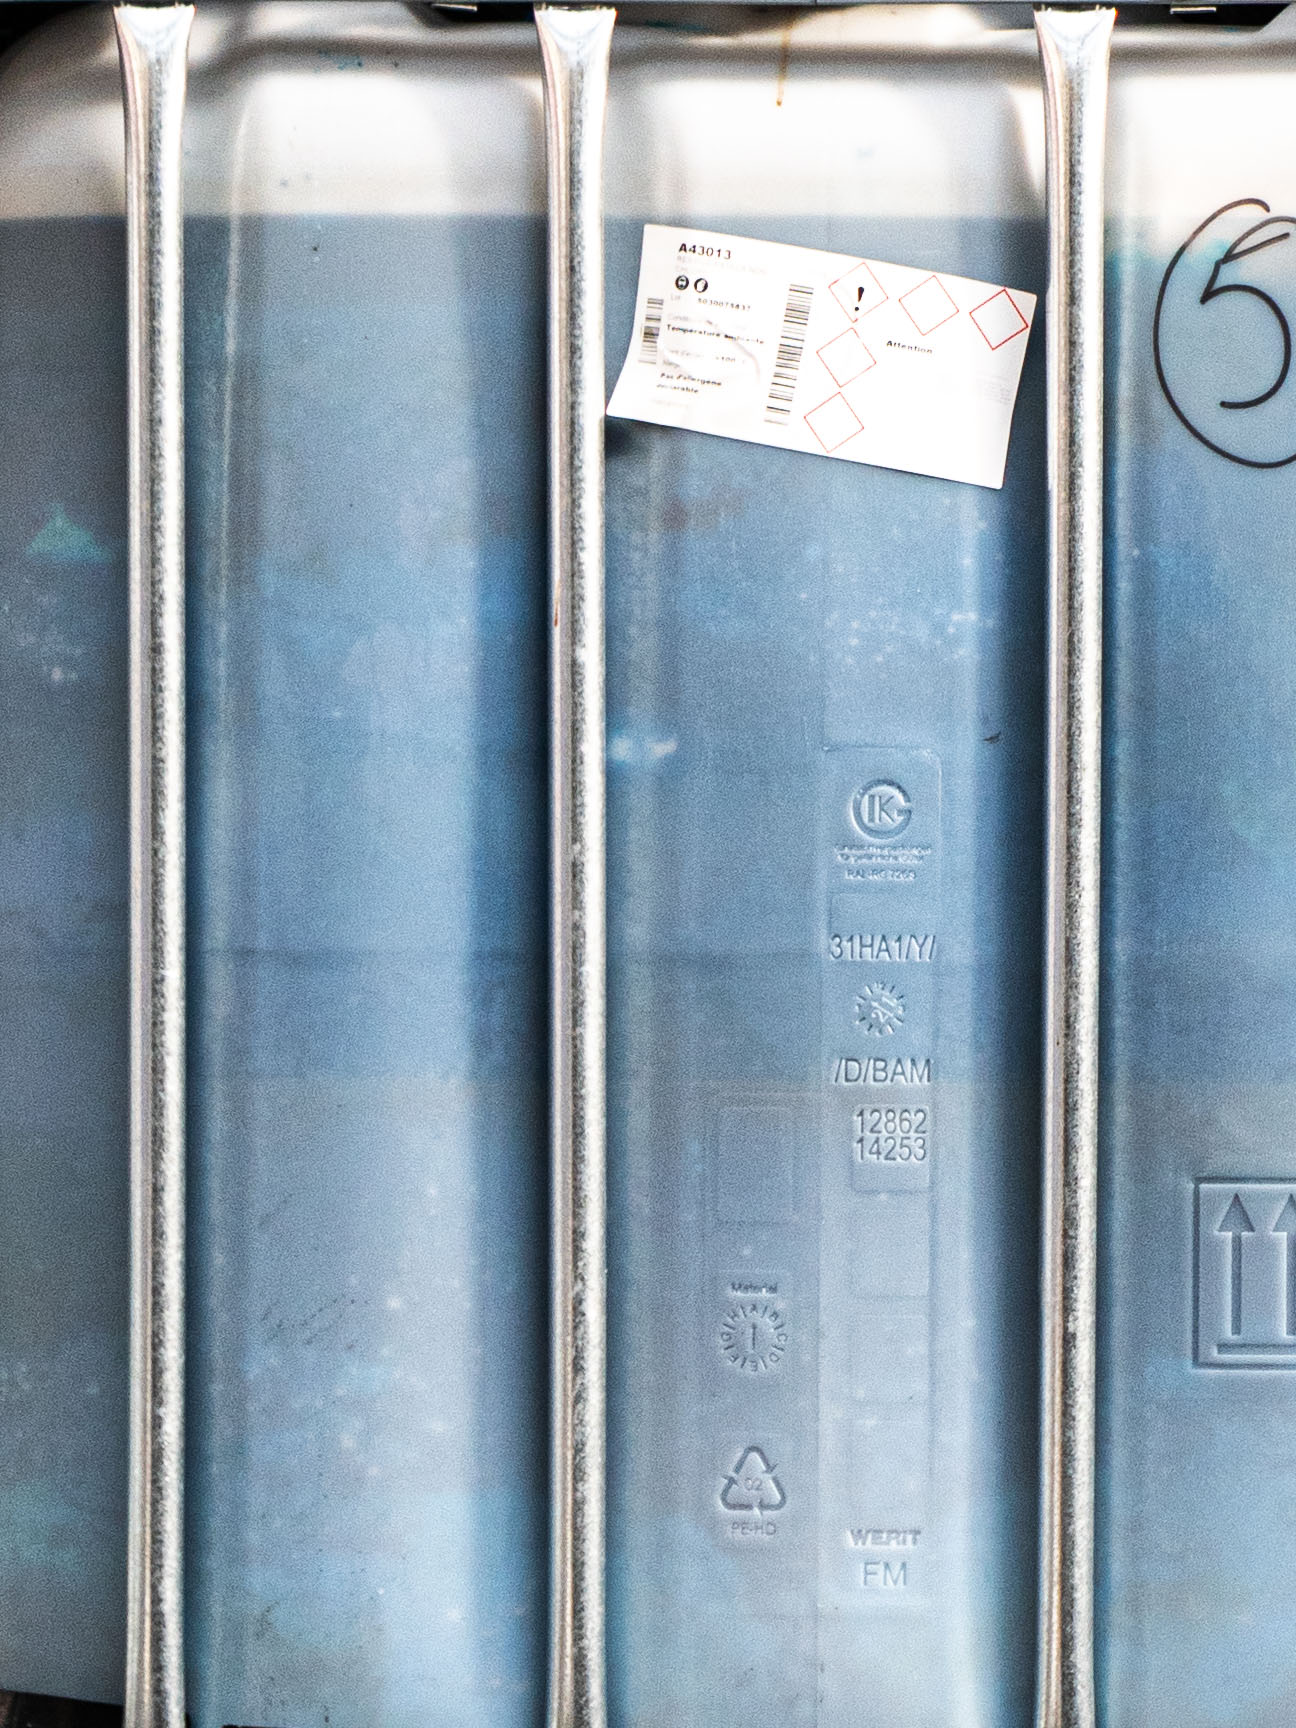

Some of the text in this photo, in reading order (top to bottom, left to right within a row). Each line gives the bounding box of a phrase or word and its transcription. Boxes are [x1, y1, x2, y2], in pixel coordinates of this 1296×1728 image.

[678, 242, 732, 260] A43013
[886, 340, 933, 354] Attention
[856, 1108, 928, 1135] 12862
[855, 1135, 928, 1161] 14253
[862, 1561, 908, 1588] FM
